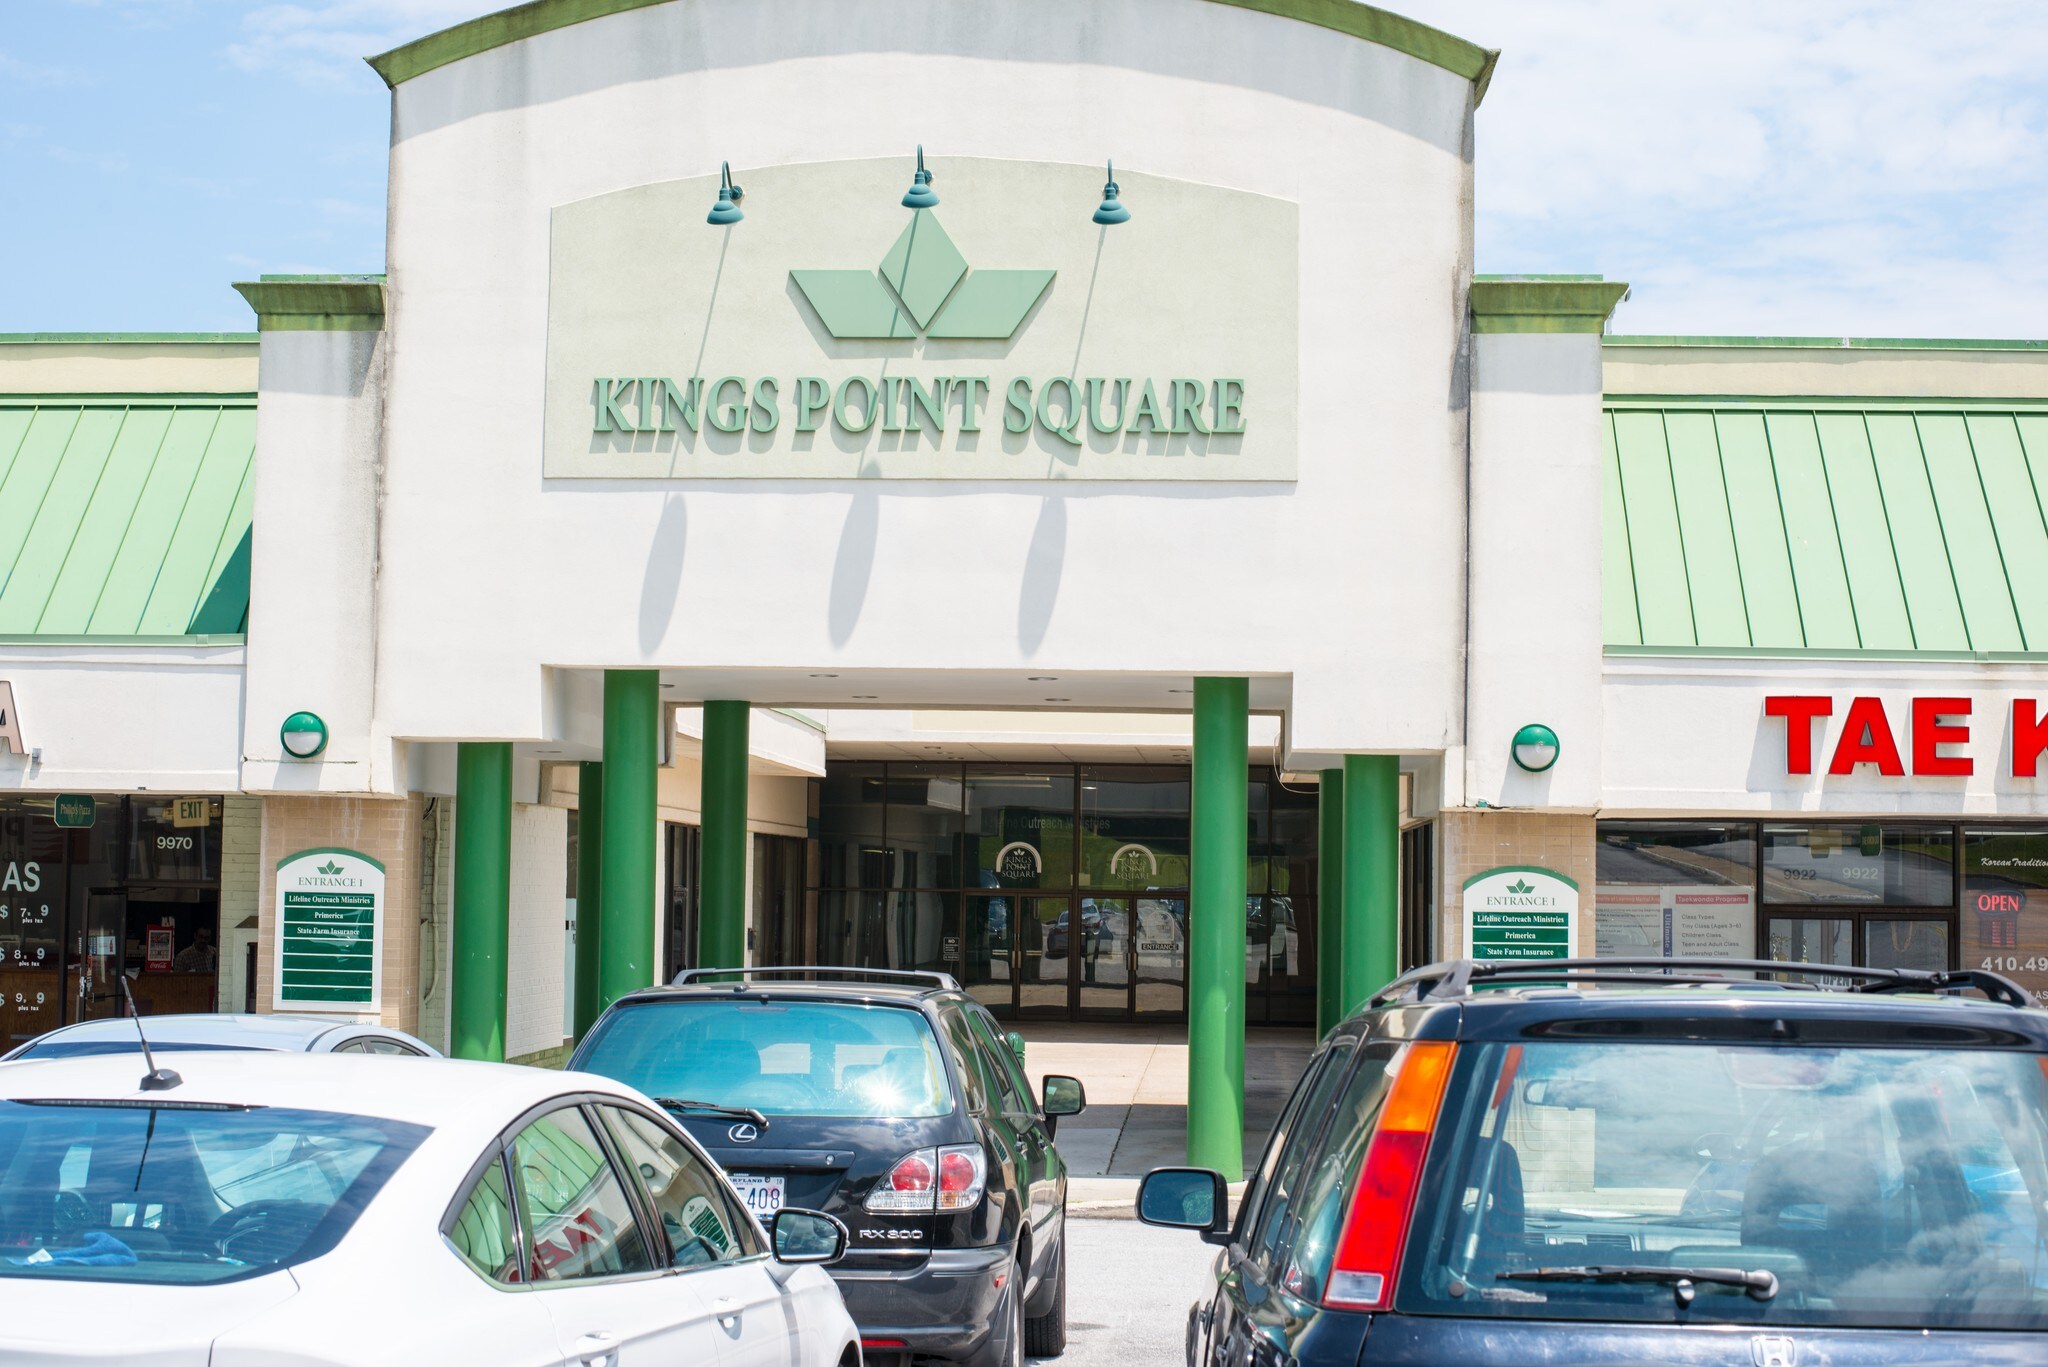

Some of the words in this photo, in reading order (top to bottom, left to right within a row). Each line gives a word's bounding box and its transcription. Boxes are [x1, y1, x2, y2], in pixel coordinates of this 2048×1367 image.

[593, 376, 780, 434] KINGS
[796, 376, 990, 434] POINT
[1003, 376, 1248, 445] SQUARE
[1764, 696, 1974, 777] TAE
[180, 801, 204, 819] EXIT
[156, 836, 193, 850] 9970
[1006, 856, 1032, 864] KINGS
[1980, 857, 2011, 867] Korean
[1006, 863, 1032, 871] POINT
[1, 861, 41, 893] AS
[1001, 870, 1036, 880] SQUARE
[1842, 867, 1879, 880] 9922
[298, 876, 357, 887] ENTRANCE
[312, 895, 340, 903] Outreach
[341, 896, 371, 904] Ministries
[1486, 896, 1548, 906] ENTRANCE
[1715, 896, 1747, 904] Programs
[1977, 894, 2020, 912] OPEN
[314, 911, 344, 919] Primerica
[1477, 915, 1501, 923] Lifeline
[1502, 915, 1532, 923] Outreach
[1533, 915, 1565, 924] Ministries
[1698, 914, 1715, 922] Types
[1663, 913, 1672, 948] Ultimate
[1681, 922, 1693, 931] Tiny
[1693, 922, 1710, 930] Class
[1710, 922, 1728, 931] (Ages
[313, 927, 329, 935] Farm
[331, 928, 360, 936] Insurance
[1505, 931, 1536, 939] Primerica
[1487, 948, 1503, 956] State
[1504, 948, 1522, 956] Farm
[1523, 948, 1554, 956] Insurance
[1681, 950, 1710, 958] Leadership
[17, 1004, 29, 1012] plus
[859, 1229, 886, 1240] RX
[886, 1229, 924, 1240] 300
